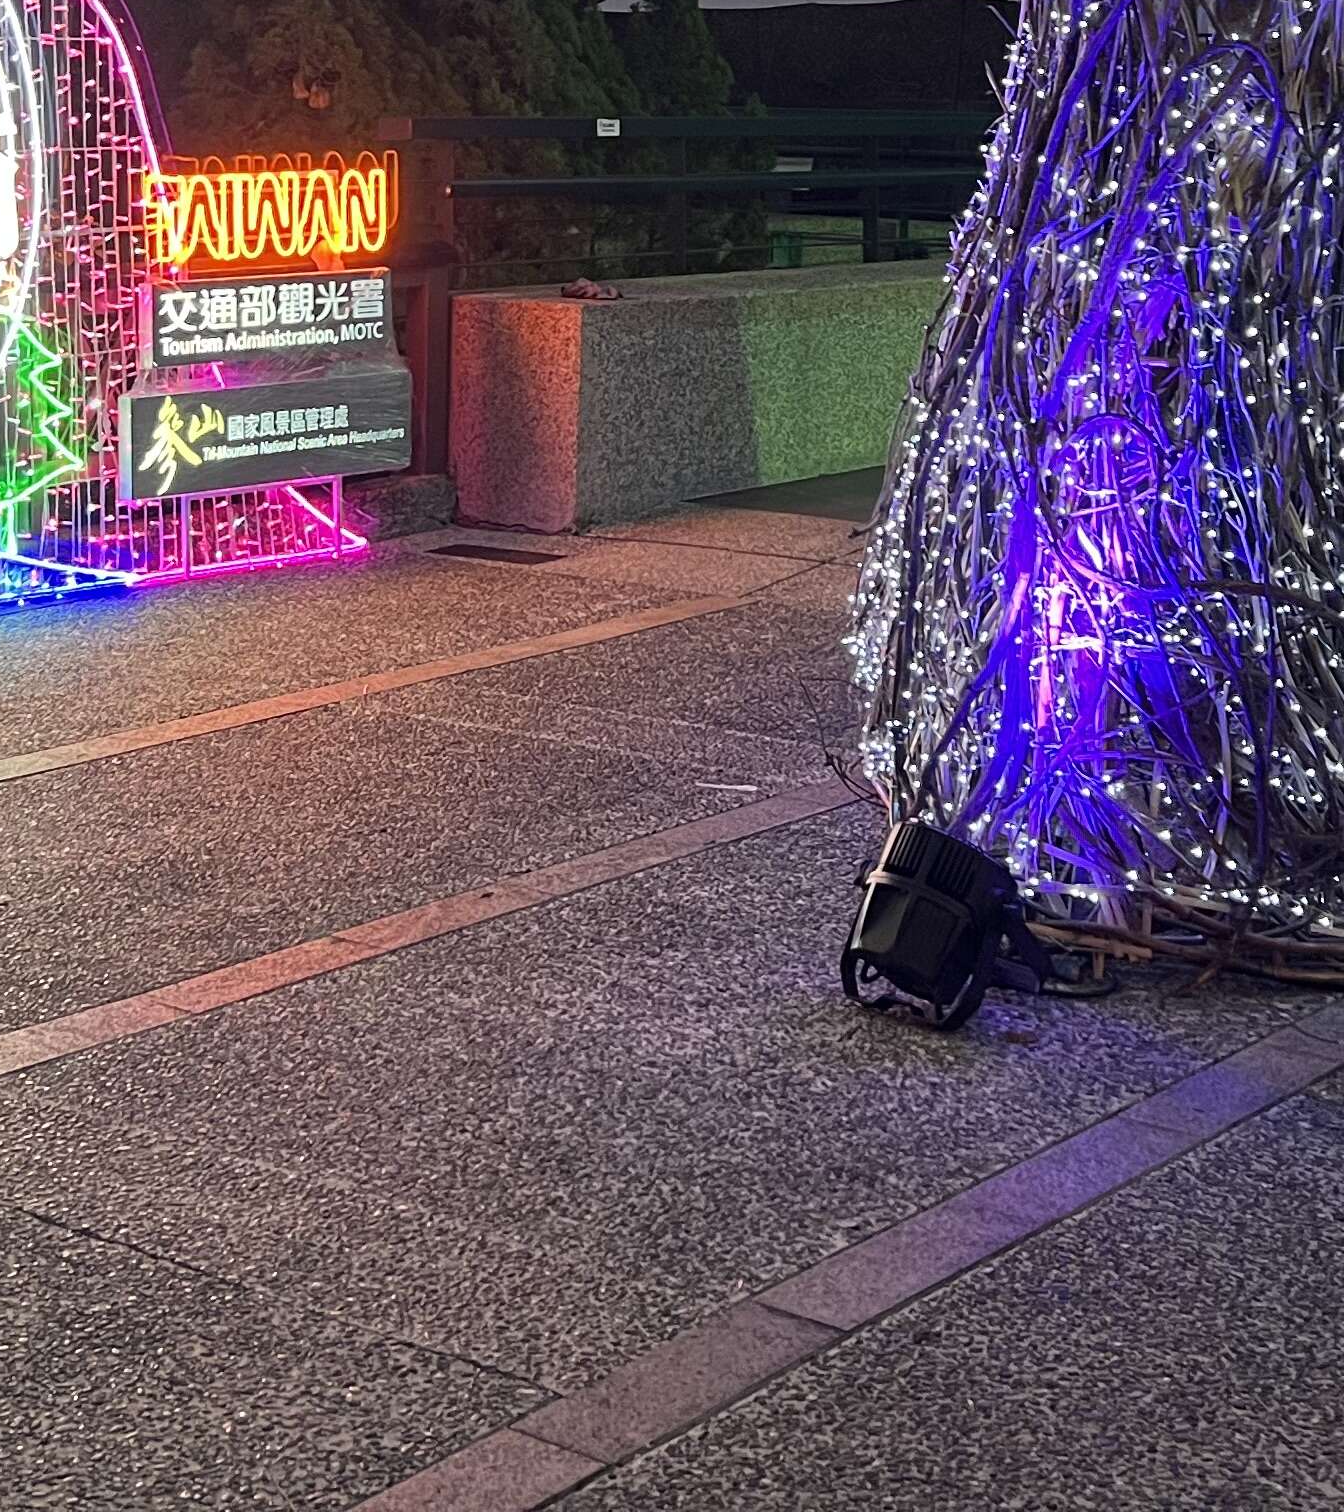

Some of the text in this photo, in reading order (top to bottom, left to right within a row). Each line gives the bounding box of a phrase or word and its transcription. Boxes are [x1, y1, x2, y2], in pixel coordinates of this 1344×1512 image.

[145, 168, 387, 264] TAIWAN
[158, 278, 385, 334] 交通部觀光署
[160, 321, 384, 357] Tourism Administration, MOTC
[227, 404, 350, 442] 國家風景區管理處
[259, 437, 297, 455] National
[297, 434, 327, 451] Scenic
[327, 432, 349, 447] Area
[349, 427, 405, 445] Headquarters
